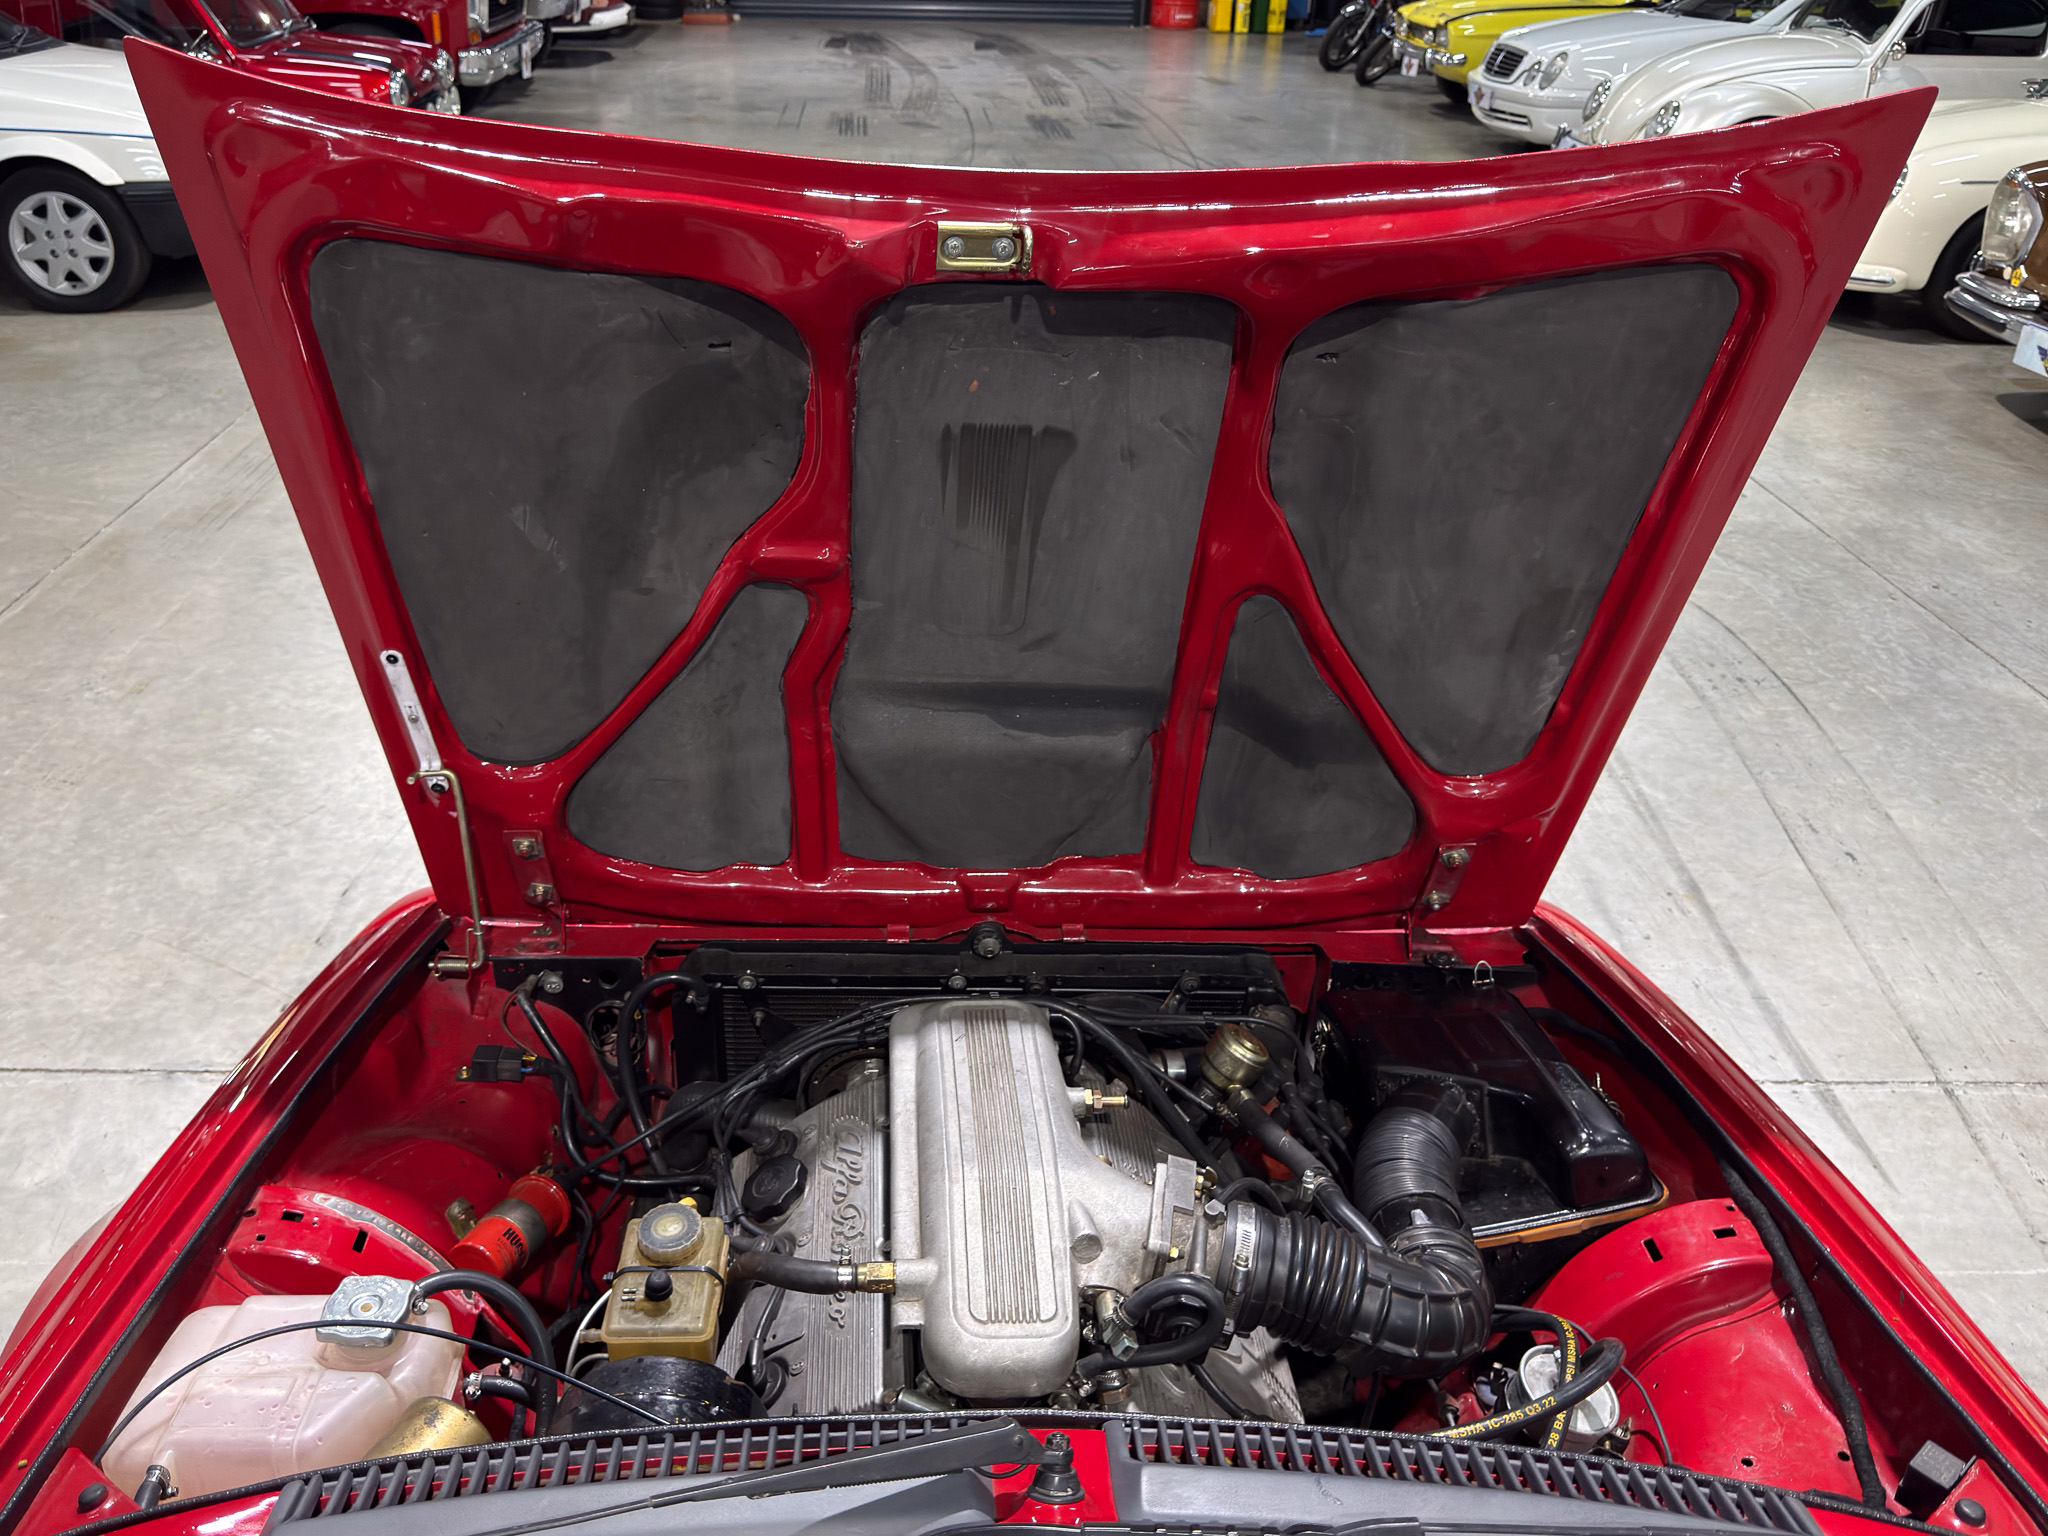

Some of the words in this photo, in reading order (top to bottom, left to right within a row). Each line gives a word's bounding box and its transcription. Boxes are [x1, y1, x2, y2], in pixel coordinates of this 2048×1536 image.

[1567, 1340, 1577, 1363] MSHA
[1565, 1365, 1575, 1381] PSI
[1448, 1423, 1486, 1438] MSHA
[1488, 1410, 1524, 1430] IC-285
[1526, 1396, 1557, 1415] Q3.22
[1548, 1432, 1561, 1447] 28
